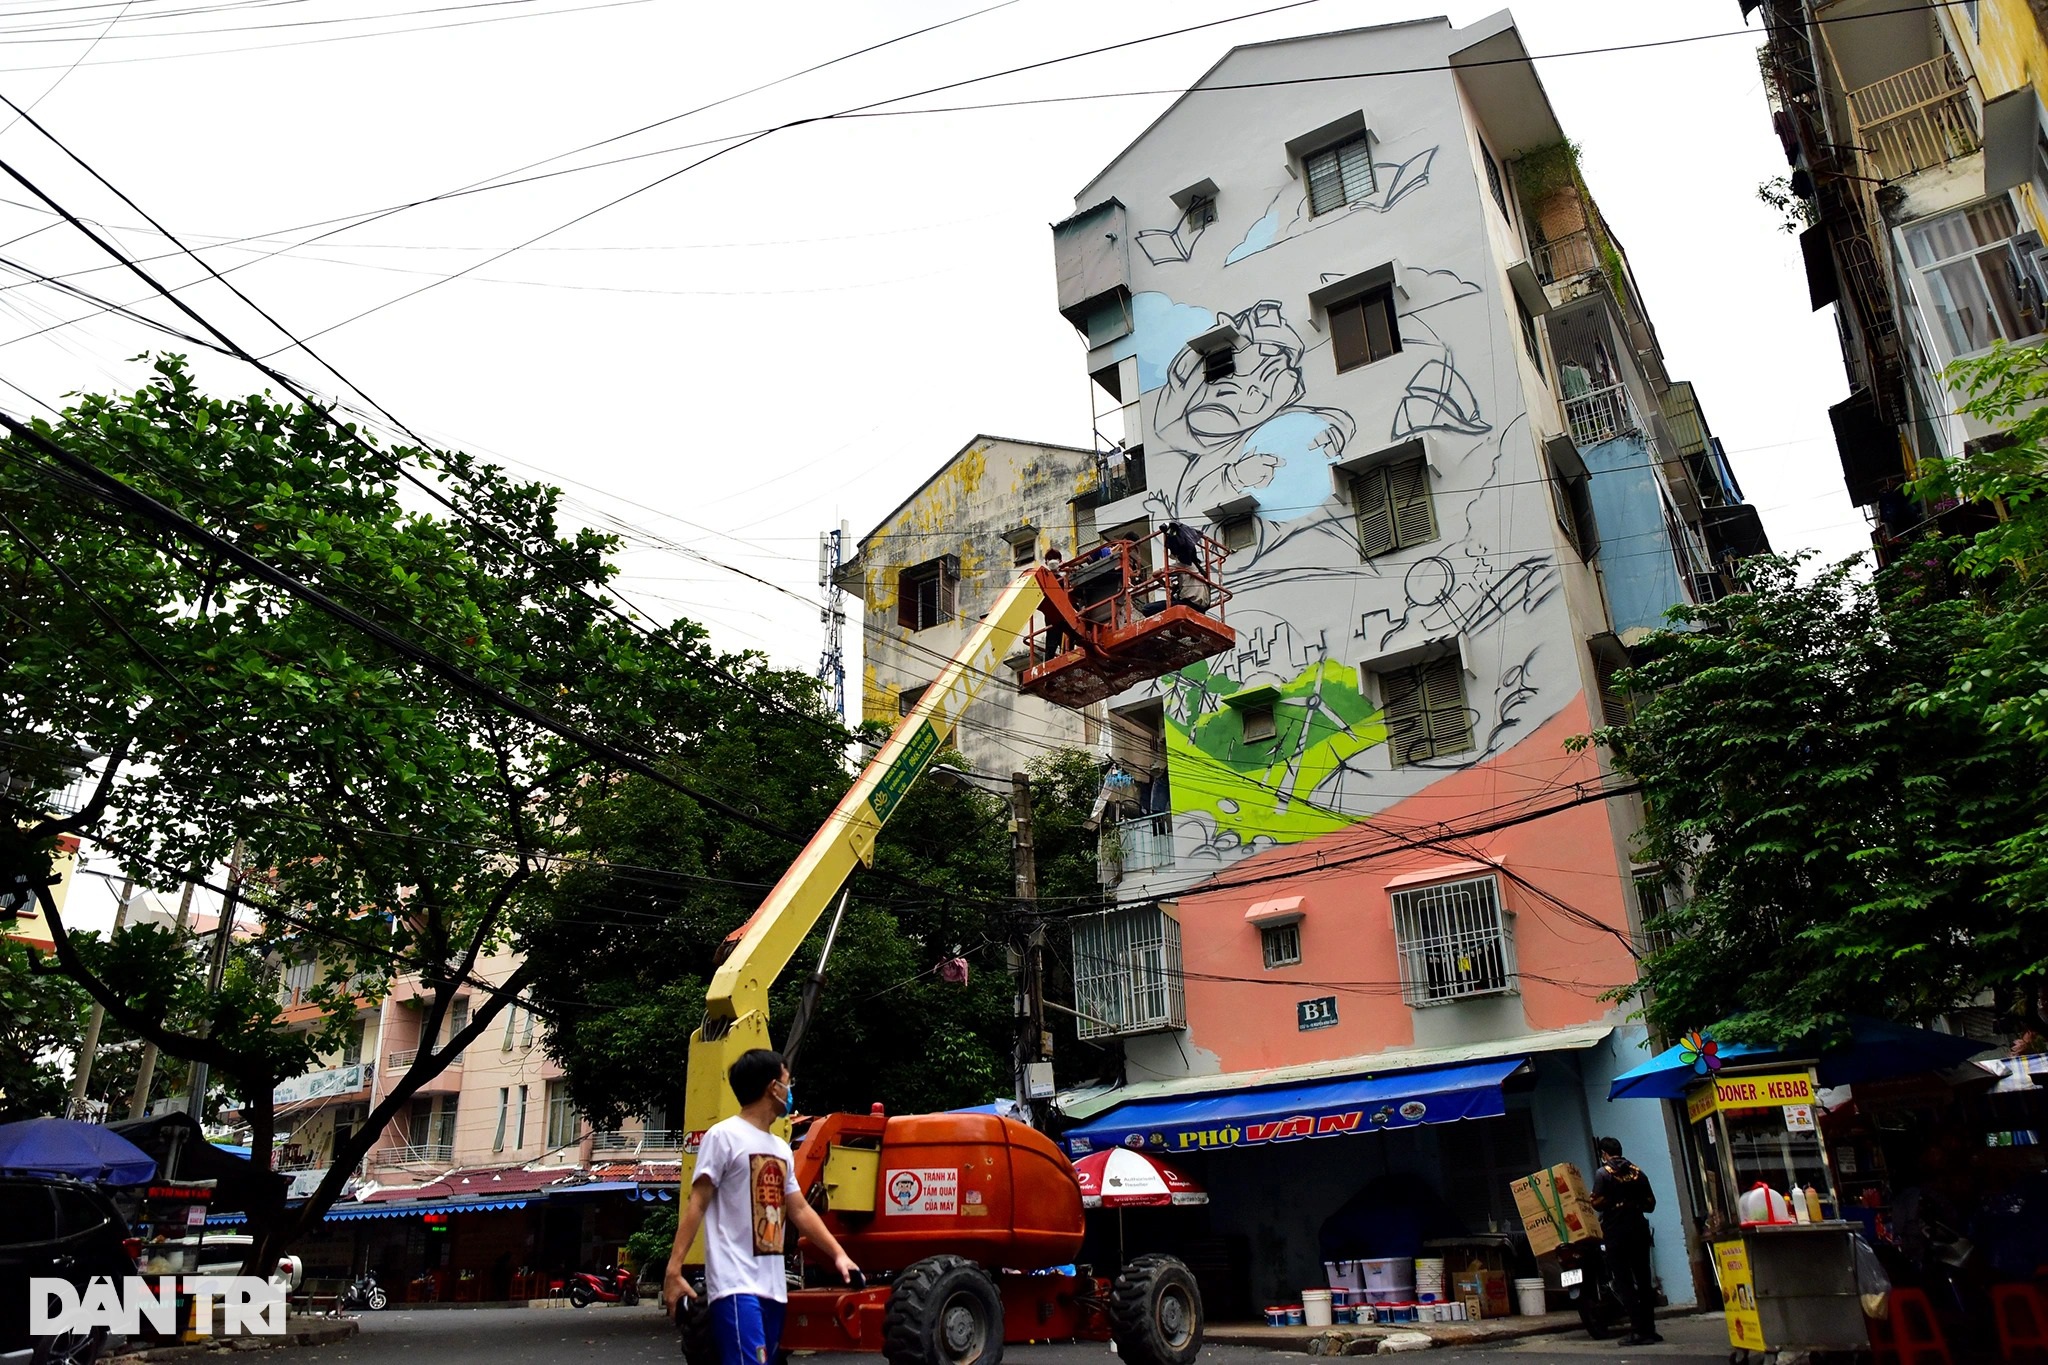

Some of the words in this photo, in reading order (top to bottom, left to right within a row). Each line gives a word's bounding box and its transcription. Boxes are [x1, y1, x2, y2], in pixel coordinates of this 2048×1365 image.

[1303, 1001, 1331, 1021] B1
[1718, 1083, 1758, 1102] DONER
[1767, 1080, 1809, 1098] KEBAB
[1178, 1124, 1242, 1148] PHỞ
[1247, 1111, 1363, 1141] VÂN
[924, 1170, 945, 1181] TRÁNH
[947, 1172, 956, 1181] XA
[939, 1187, 956, 1196] QUAY
[925, 1199, 938, 1211] CỦA
[940, 1200, 954, 1211] MÁY
